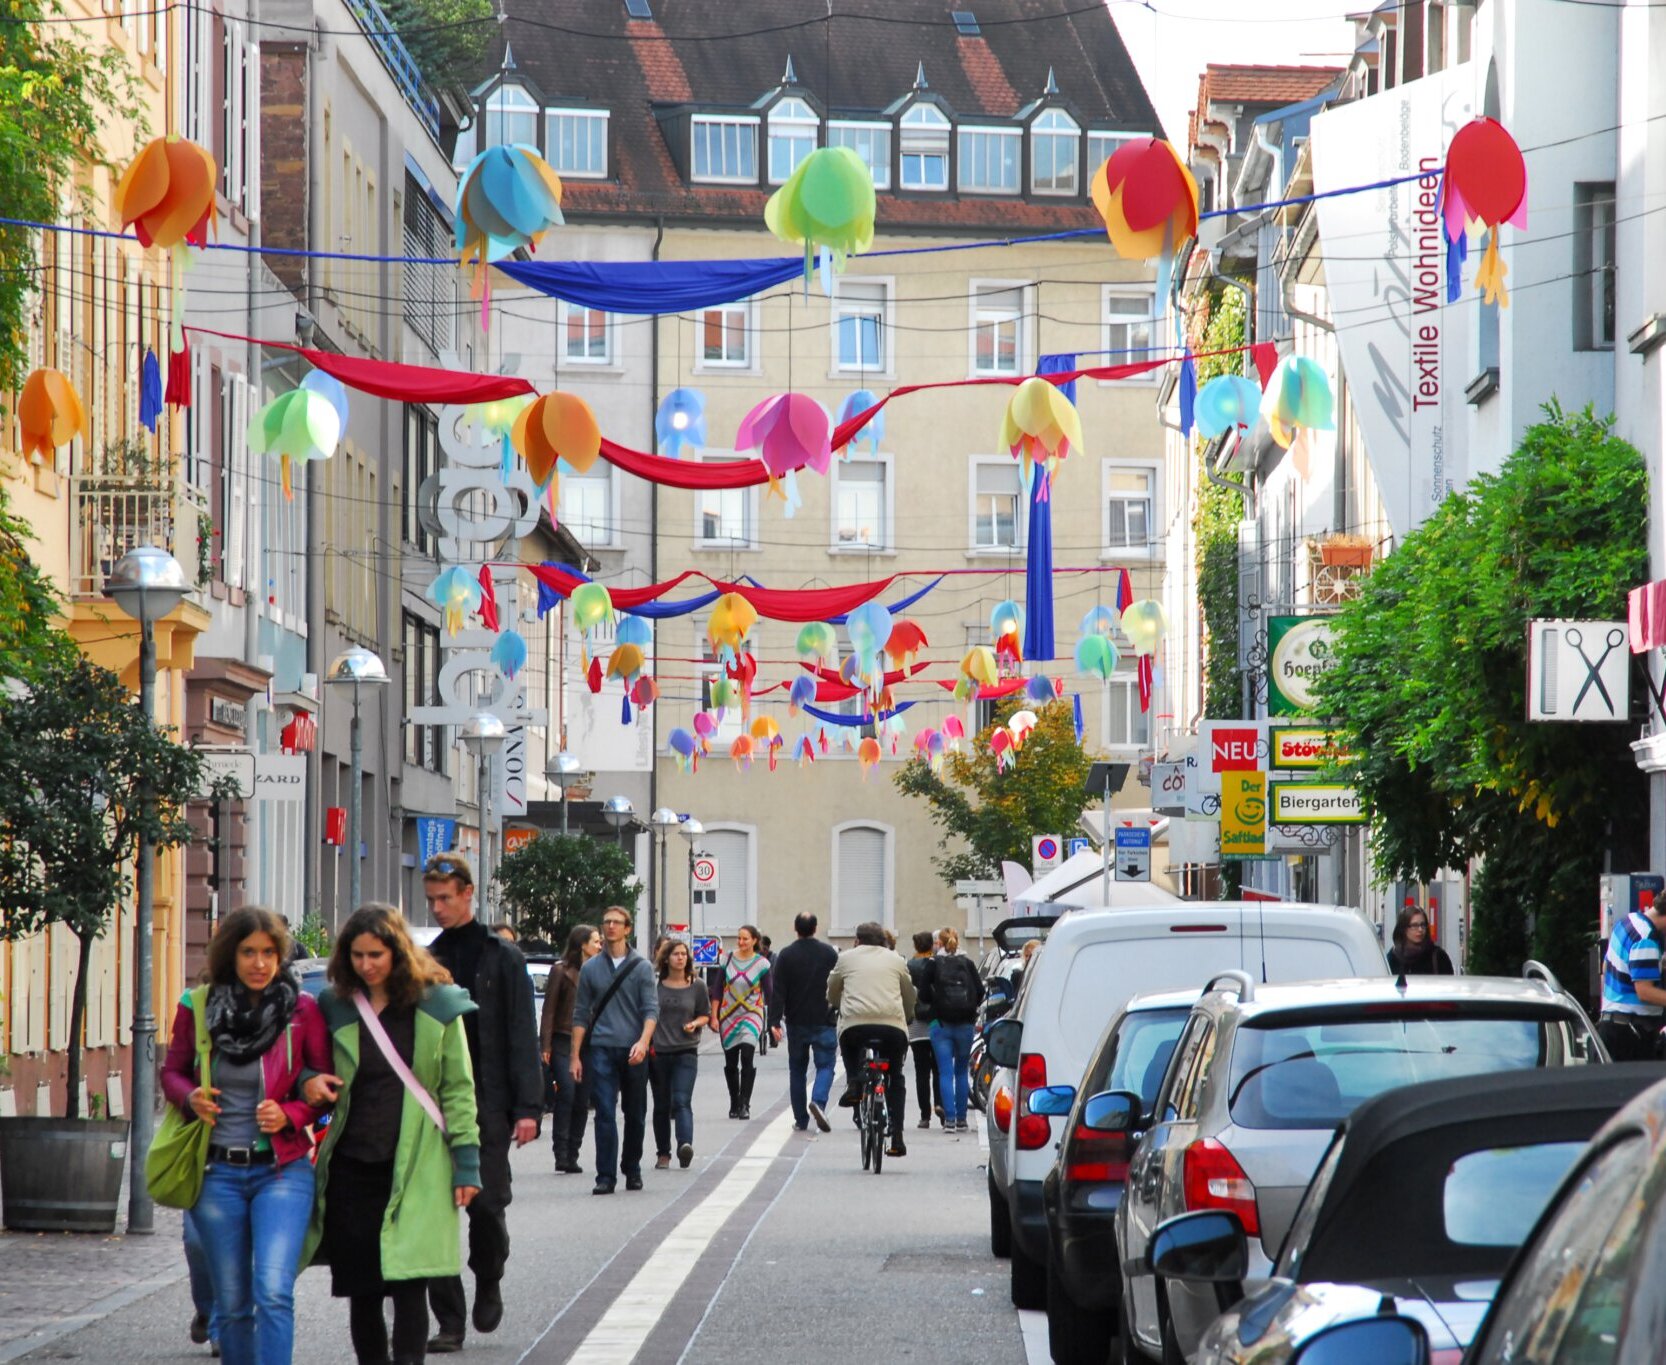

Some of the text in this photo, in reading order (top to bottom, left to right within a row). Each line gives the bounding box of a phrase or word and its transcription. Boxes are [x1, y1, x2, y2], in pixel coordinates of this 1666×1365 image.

[1412, 157, 1439, 412] Textile Wohnideen
[1431, 425, 1443, 501] Sonnenschutz
[1212, 741, 1258, 760] NEU
[1241, 779, 1262, 793] Der
[1280, 796, 1360, 811] Biergarten
[697, 865, 711, 876] 30
